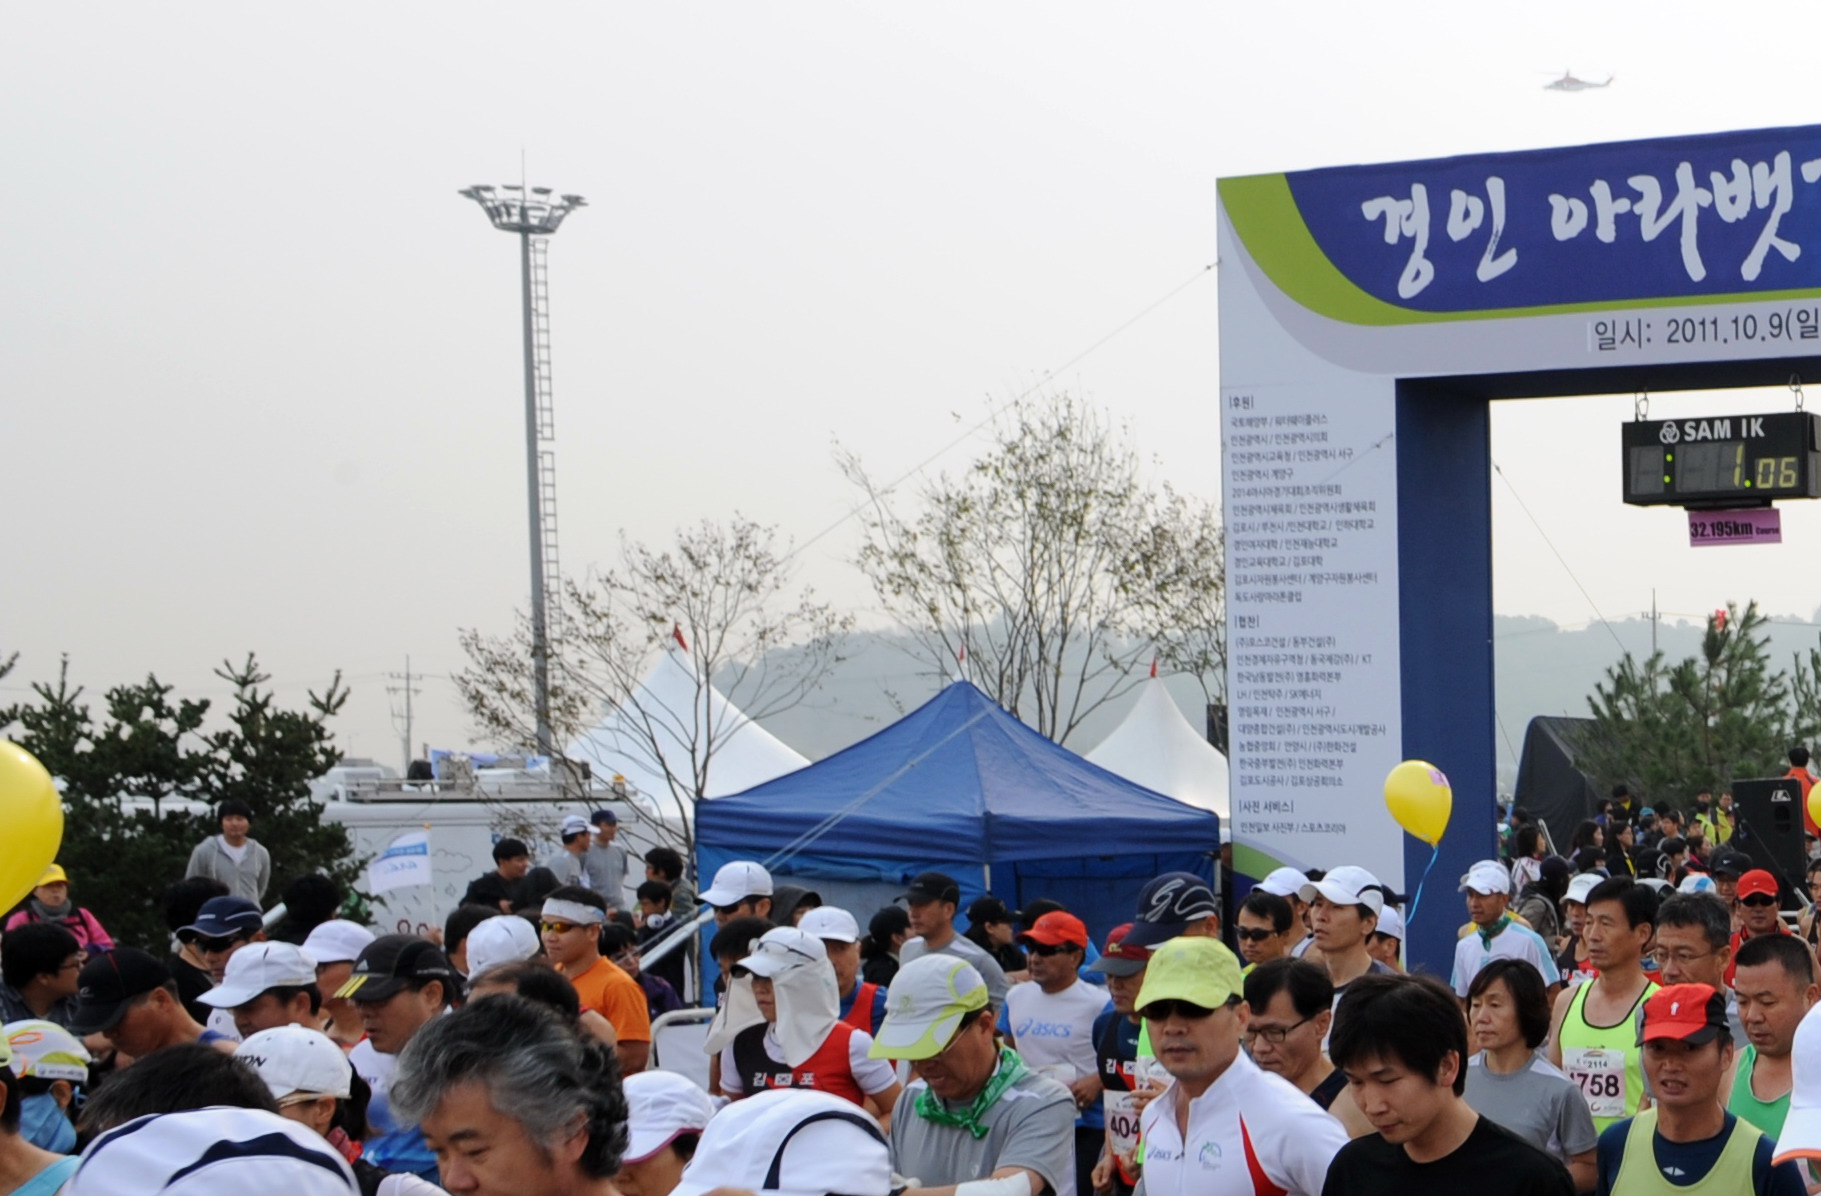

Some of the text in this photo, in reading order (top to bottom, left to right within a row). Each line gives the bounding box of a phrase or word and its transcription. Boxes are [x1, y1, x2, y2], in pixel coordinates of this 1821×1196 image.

[1361, 176, 1518, 299] 경인
[1593, 313, 1652, 349] 일시:
[1684, 417, 1765, 441] SAM IK
[1690, 520, 1753, 539] 32.195km
[1031, 1022, 1073, 1038] asics
[1587, 1060, 1608, 1069] 2114
[753, 1072, 768, 1087] 김
[1569, 1072, 1620, 1098] 758
